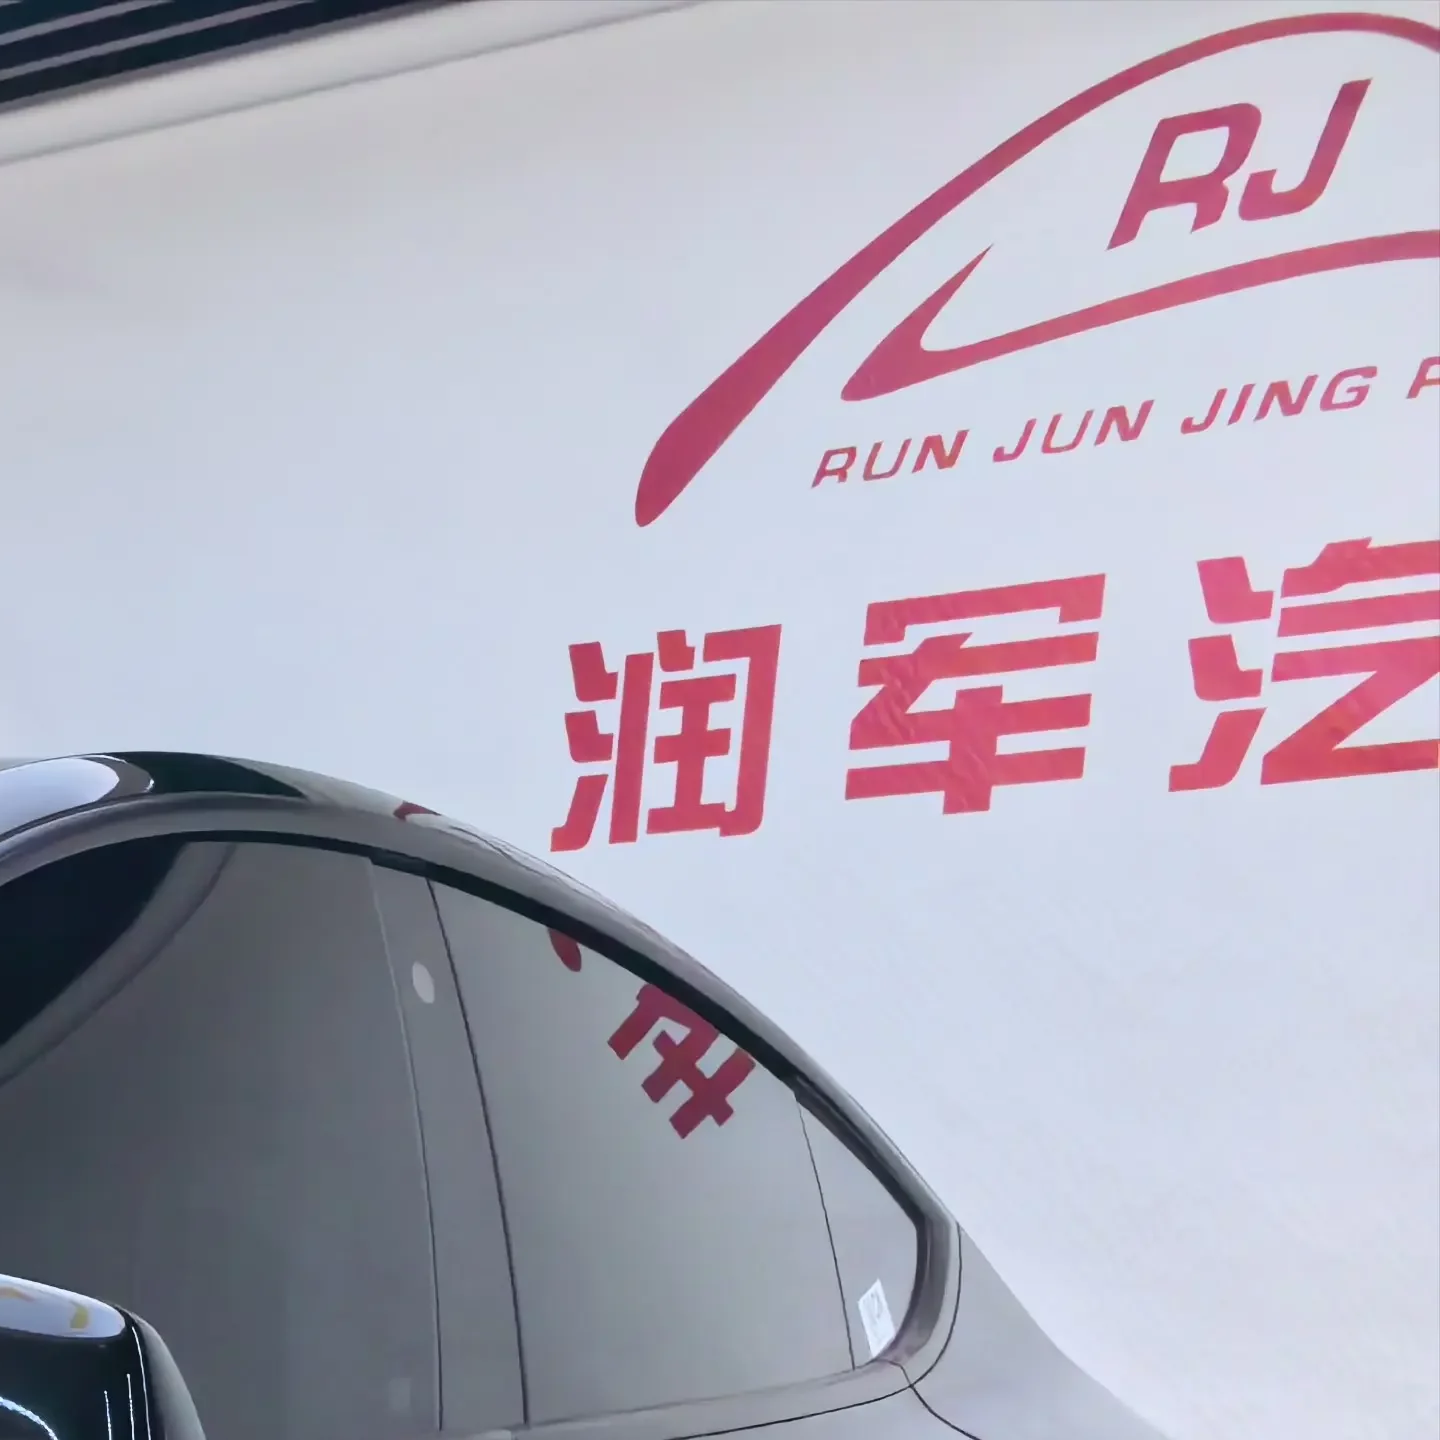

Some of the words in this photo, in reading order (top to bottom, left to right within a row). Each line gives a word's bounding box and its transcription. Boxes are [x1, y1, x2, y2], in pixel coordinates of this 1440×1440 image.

[1107, 77, 1373, 251] RJ
[811, 428, 970, 489] RUN
[992, 399, 1155, 463] JUN
[1180, 364, 1379, 435] JING
